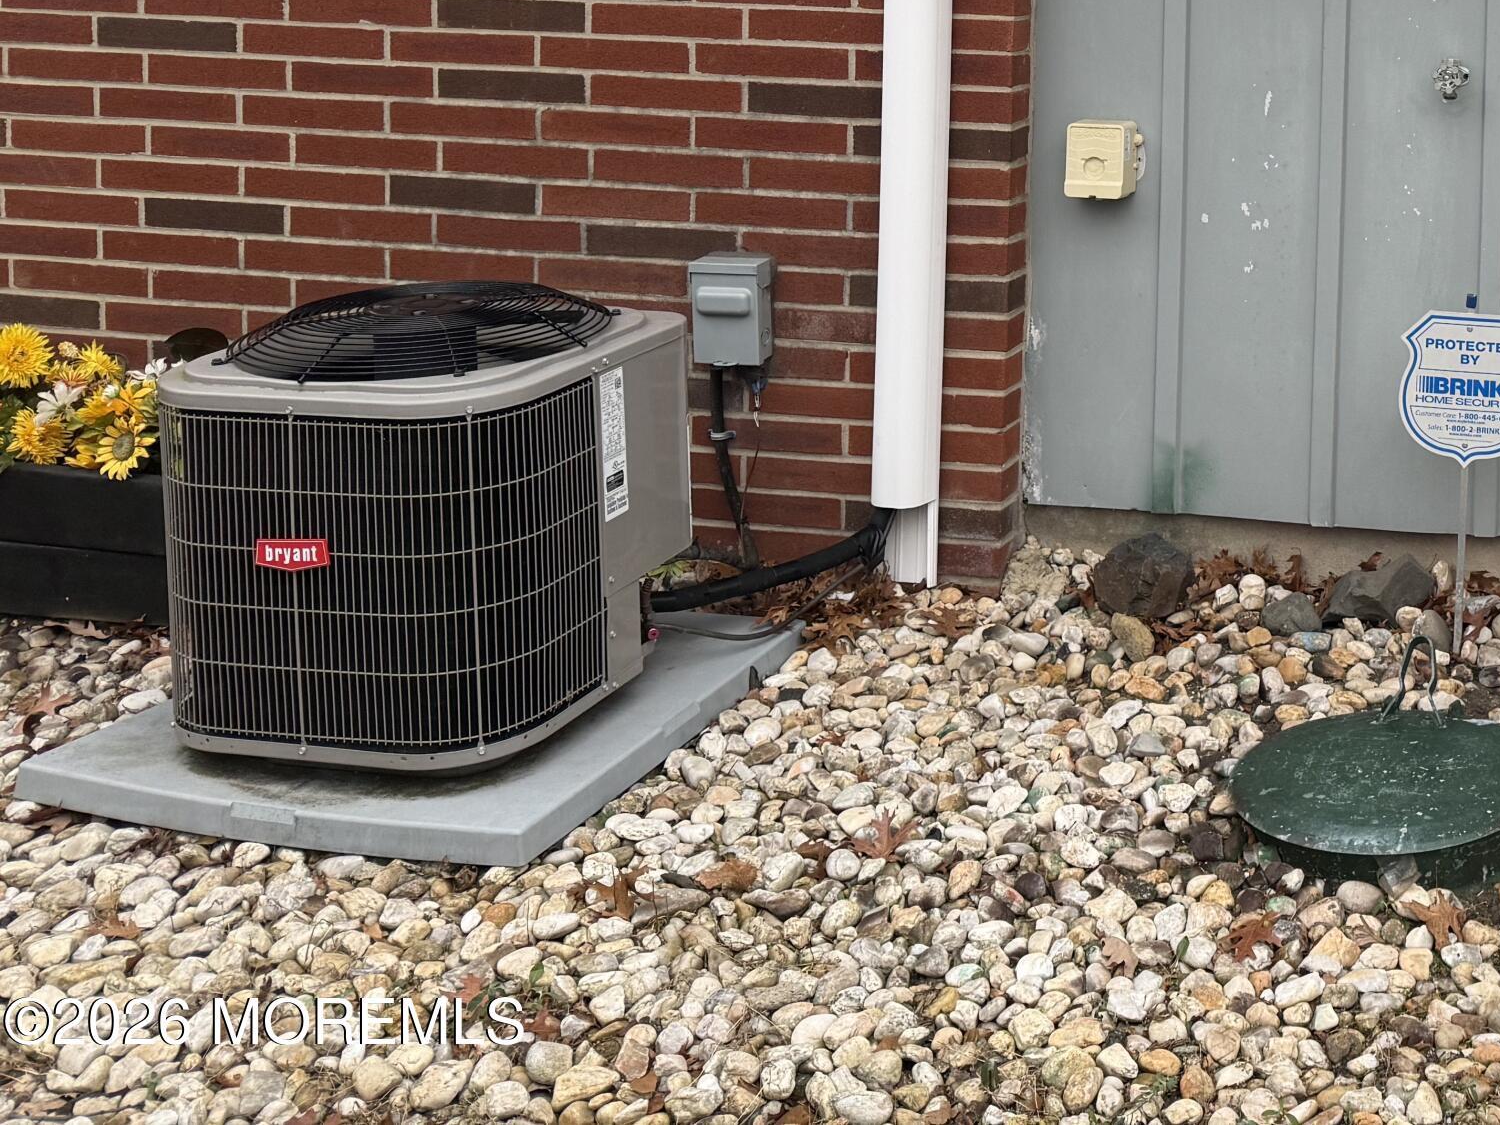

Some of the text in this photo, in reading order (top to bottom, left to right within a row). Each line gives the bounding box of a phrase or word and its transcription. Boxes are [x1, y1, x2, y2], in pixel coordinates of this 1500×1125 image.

[1460, 354, 1480, 365] BY
[1415, 394, 1453, 405] HOME
[1415, 410, 1442, 418] Customer
[265, 544, 317, 565] bryant
